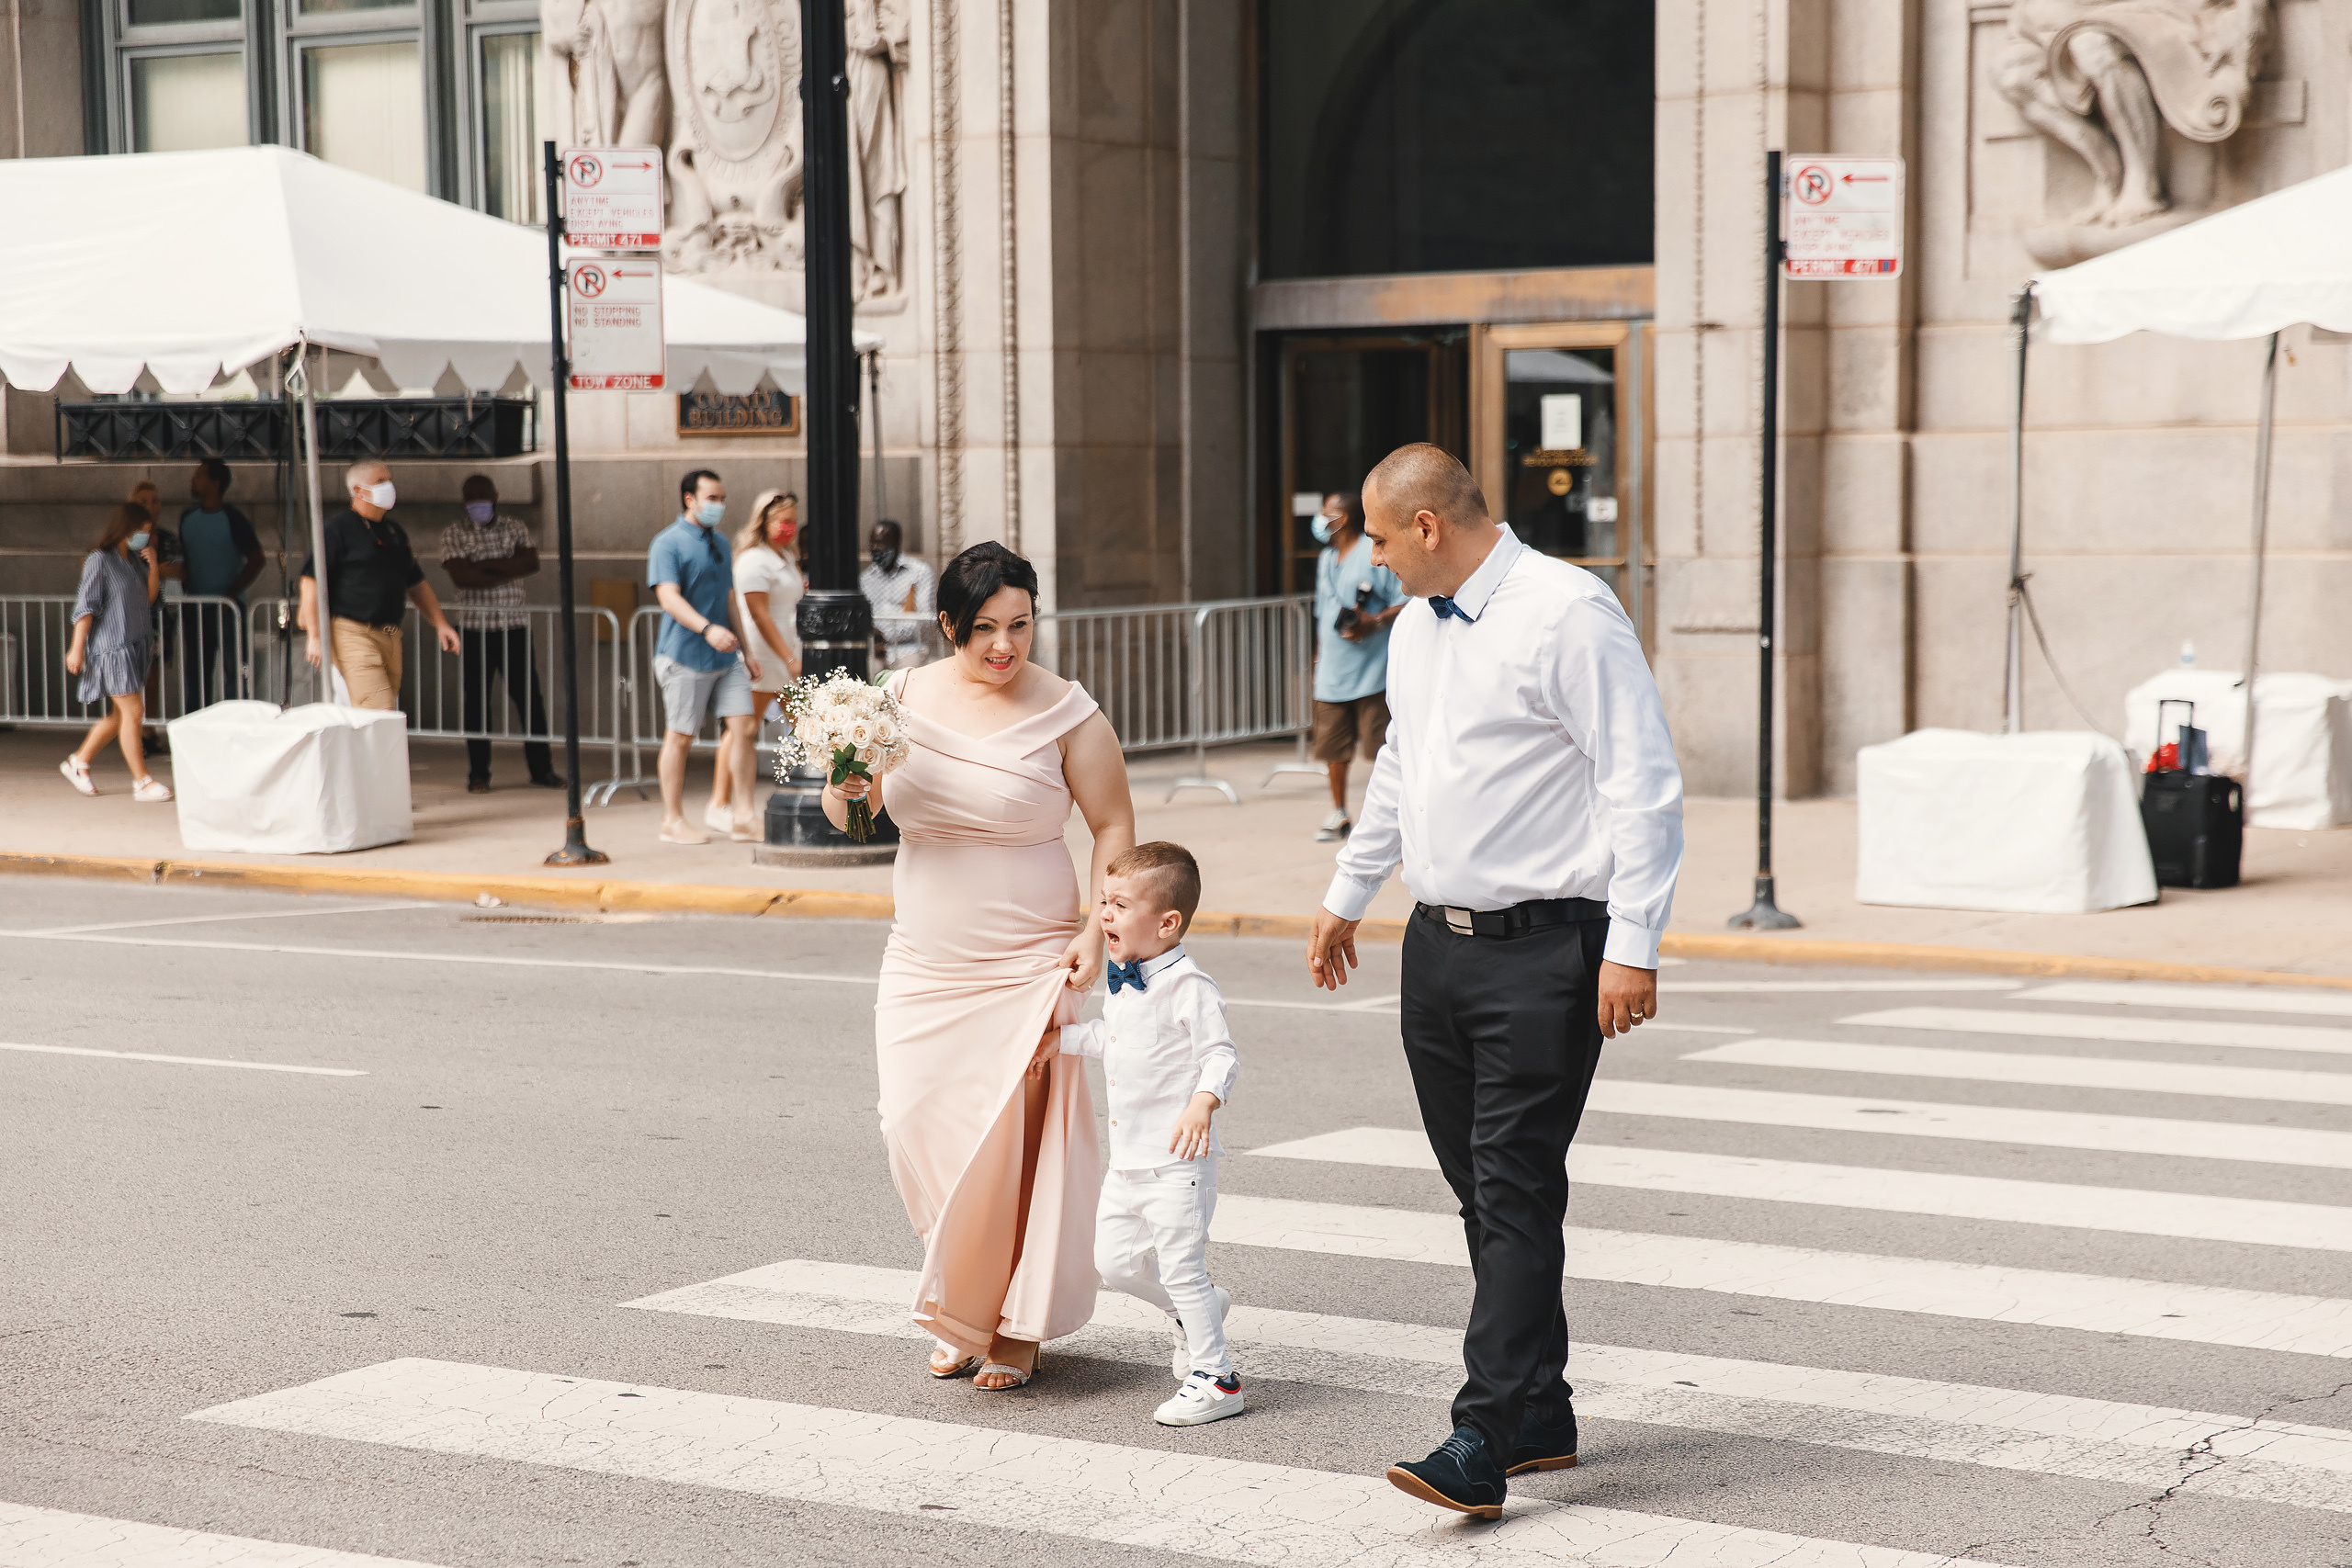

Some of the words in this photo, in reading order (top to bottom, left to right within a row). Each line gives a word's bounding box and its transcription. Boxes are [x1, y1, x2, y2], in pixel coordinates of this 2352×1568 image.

[571, 197, 610, 205] ANYTIME
[571, 209, 604, 219] EXCEPT
[611, 209, 655, 219] VEHICLES
[571, 220, 625, 230] DISPLAYING
[570, 234, 616, 247] PERMIT
[619, 234, 643, 246] 471
[574, 307, 588, 317] NO
[593, 307, 641, 317] STOPPING
[574, 318, 588, 328] NO
[593, 318, 641, 328] STANDING
[576, 376, 608, 389] TOW
[613, 376, 653, 389] ZONE
[690, 408, 783, 429] BUILDING
